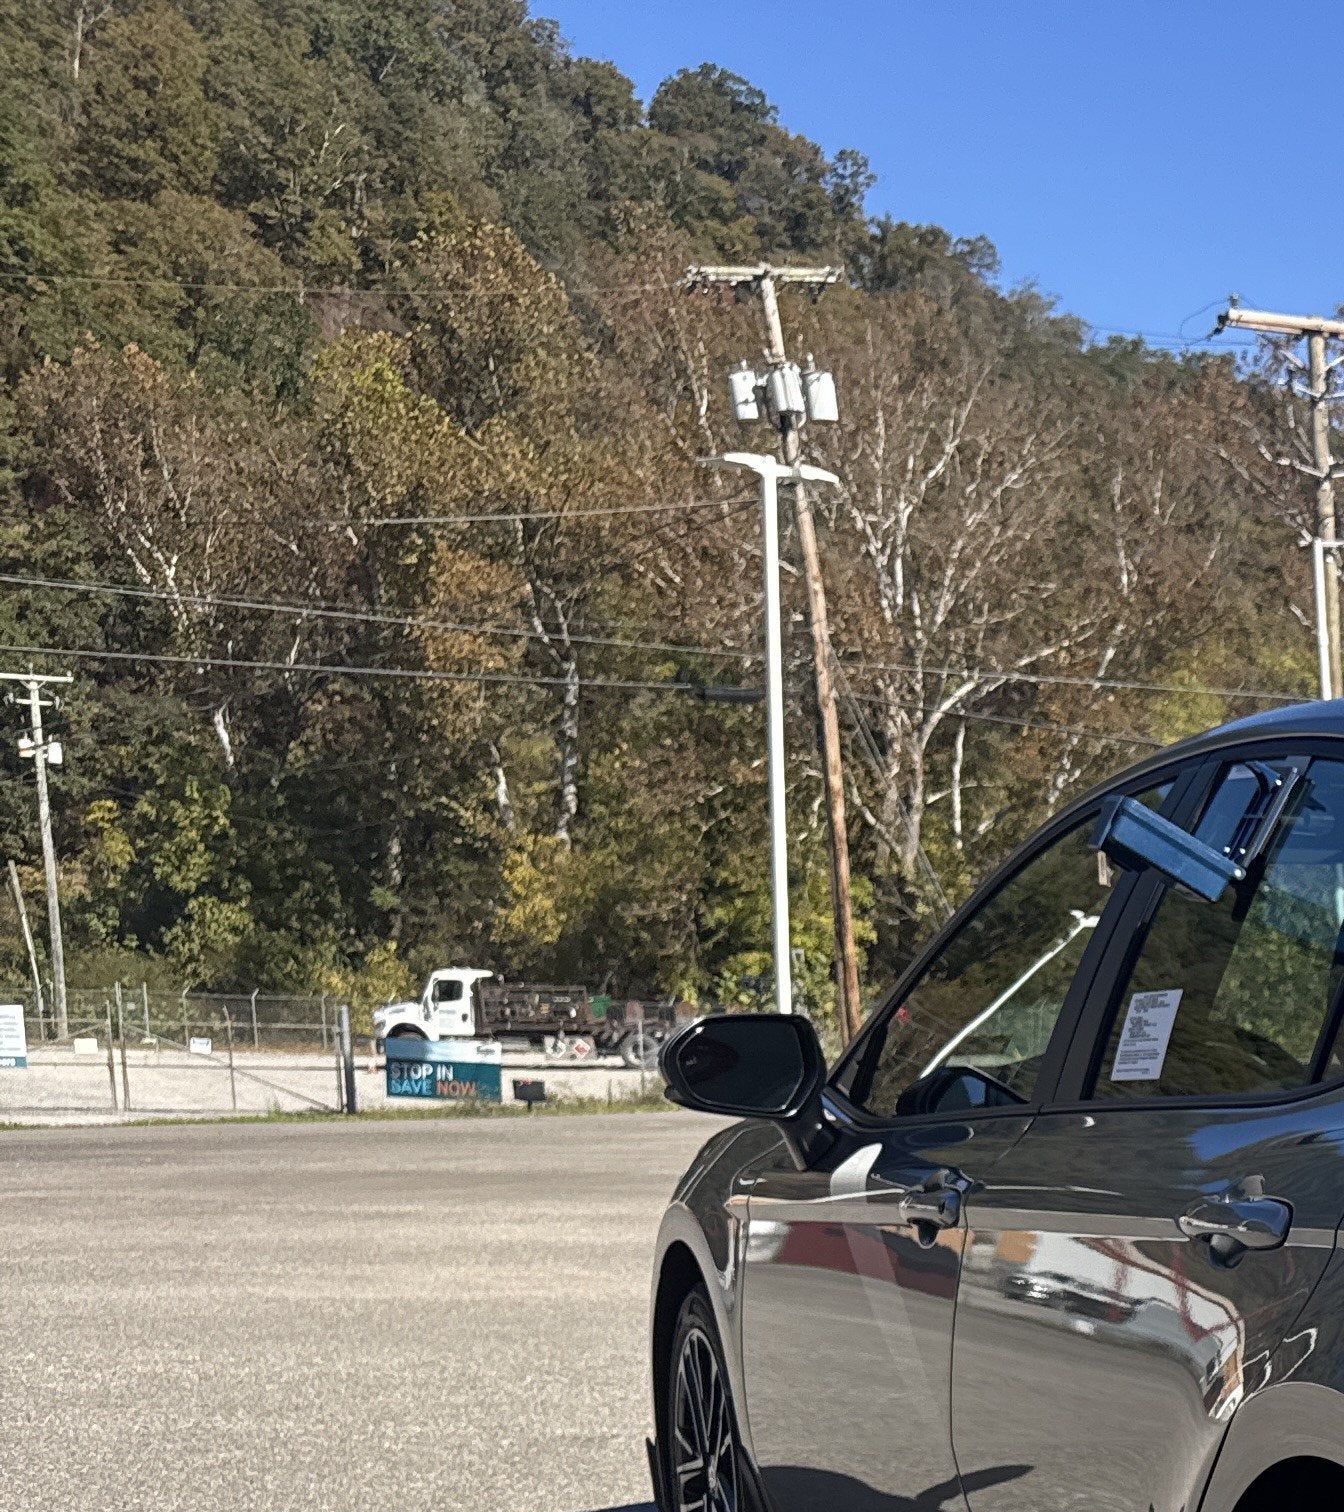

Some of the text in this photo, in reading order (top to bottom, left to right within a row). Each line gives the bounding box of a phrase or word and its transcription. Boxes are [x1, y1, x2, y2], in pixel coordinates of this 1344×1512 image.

[391, 1062, 453, 1081] STOP IN
[436, 1080, 476, 1097] NOW
